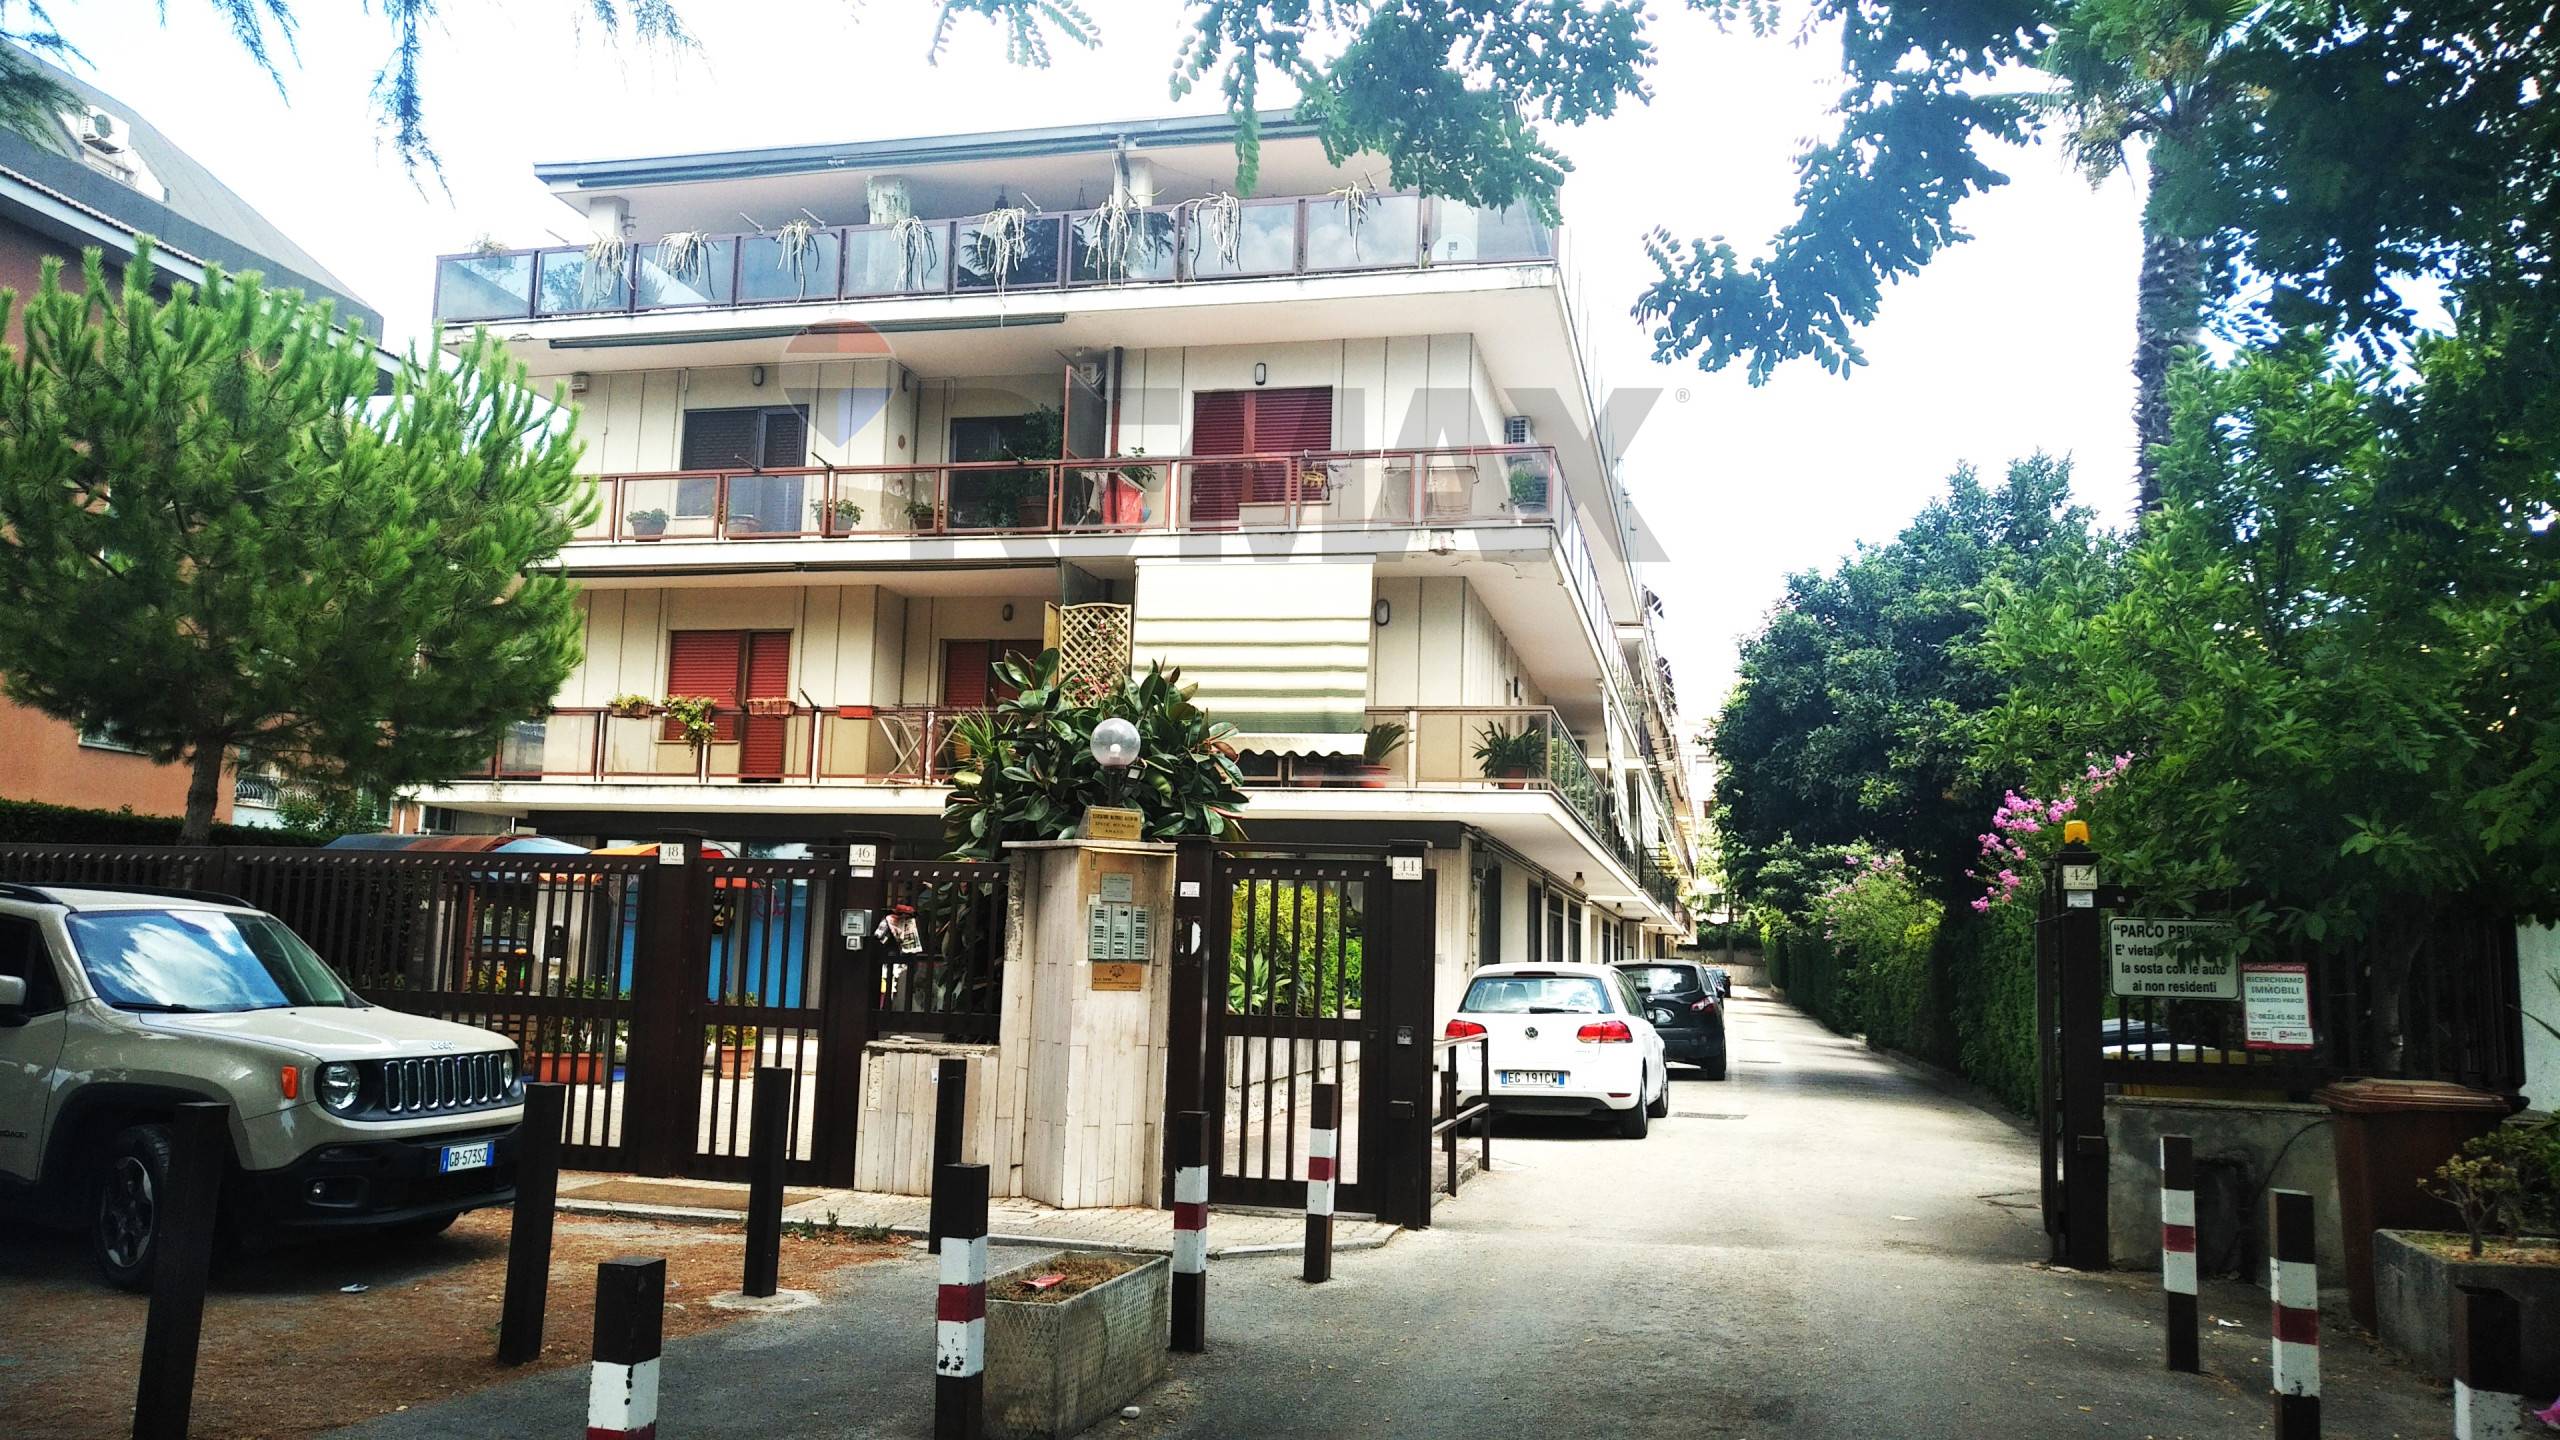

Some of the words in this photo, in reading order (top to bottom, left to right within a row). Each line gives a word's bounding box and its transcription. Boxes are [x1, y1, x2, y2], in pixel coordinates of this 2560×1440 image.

[2121, 962, 2131, 974] la
[2134, 963, 2163, 974] sosta
[2189, 963, 2199, 975] le
[2202, 964, 2227, 976] auto
[2132, 980, 2142, 992] ai
[2145, 982, 2165, 992] non
[2168, 980, 2217, 993] residenti
[2251, 986, 2300, 994] IMMOBILI
